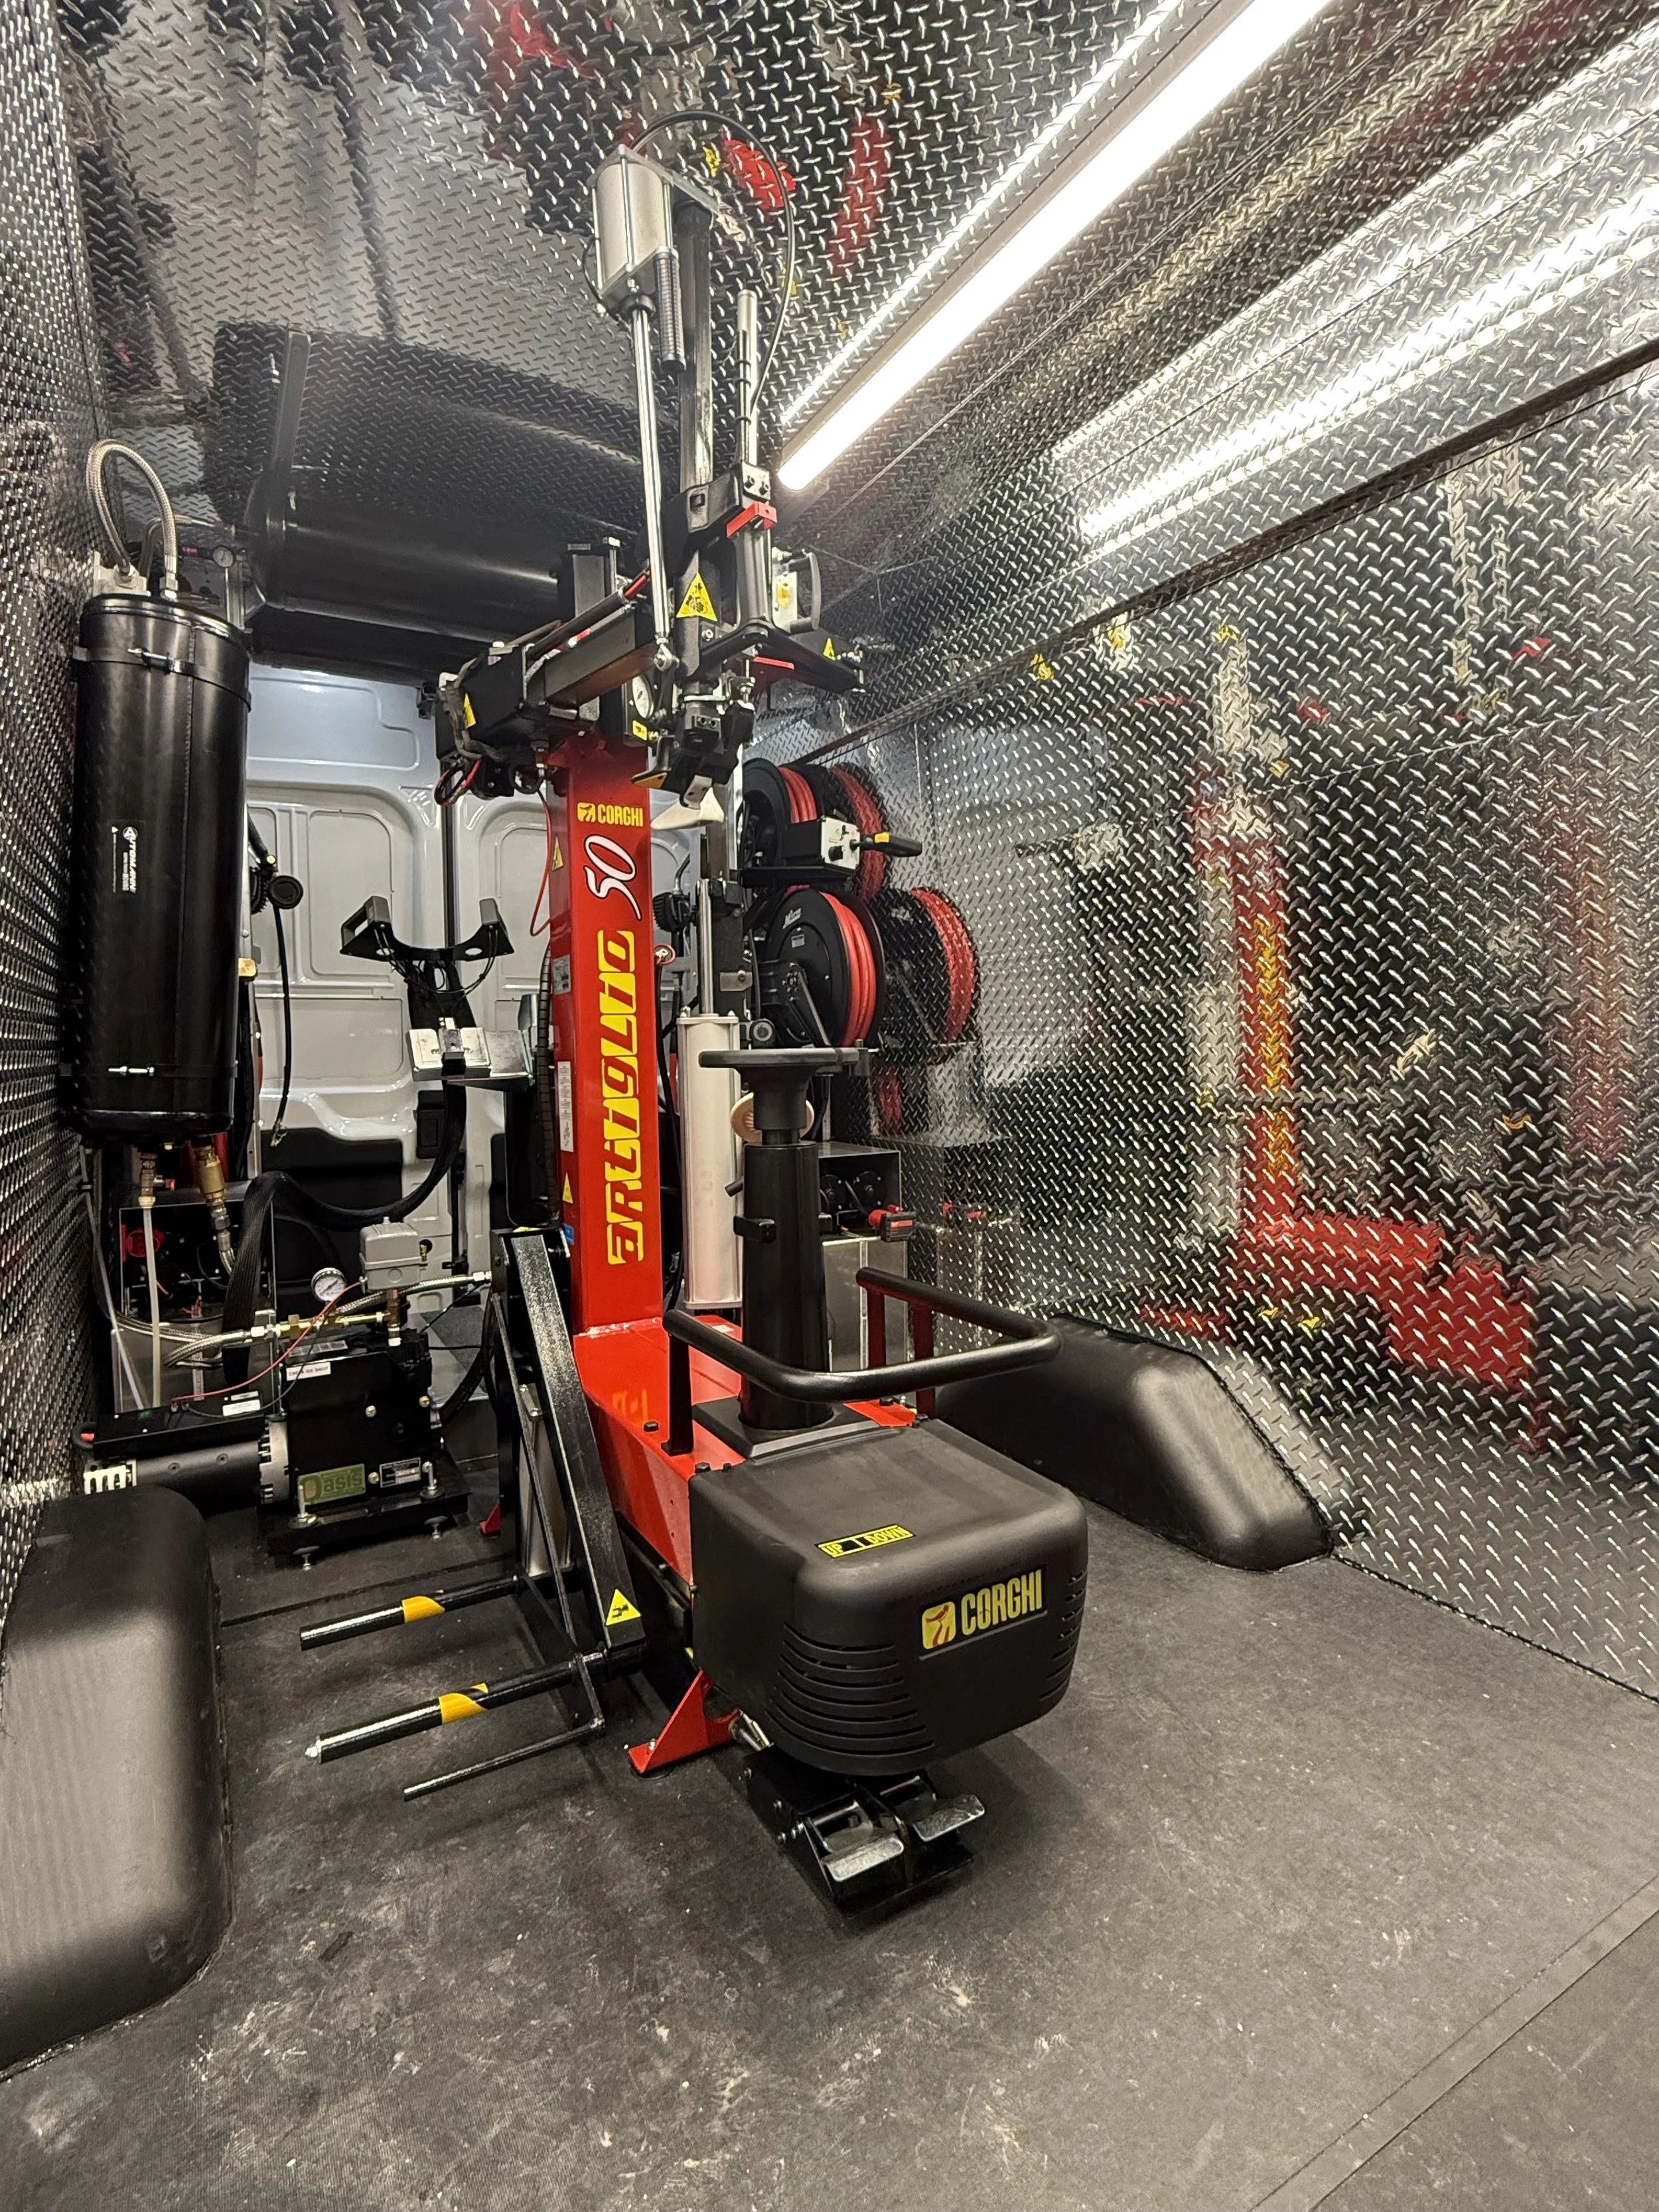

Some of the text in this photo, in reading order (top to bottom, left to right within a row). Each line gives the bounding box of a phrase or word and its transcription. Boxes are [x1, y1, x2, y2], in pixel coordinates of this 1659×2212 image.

[597, 804, 644, 827] CORGHI
[583, 834, 642, 921] 50
[300, 1470, 363, 1506] Oasis
[821, 1526, 911, 1556] UP DOWN
[962, 1569, 1042, 1636] CORGHI
